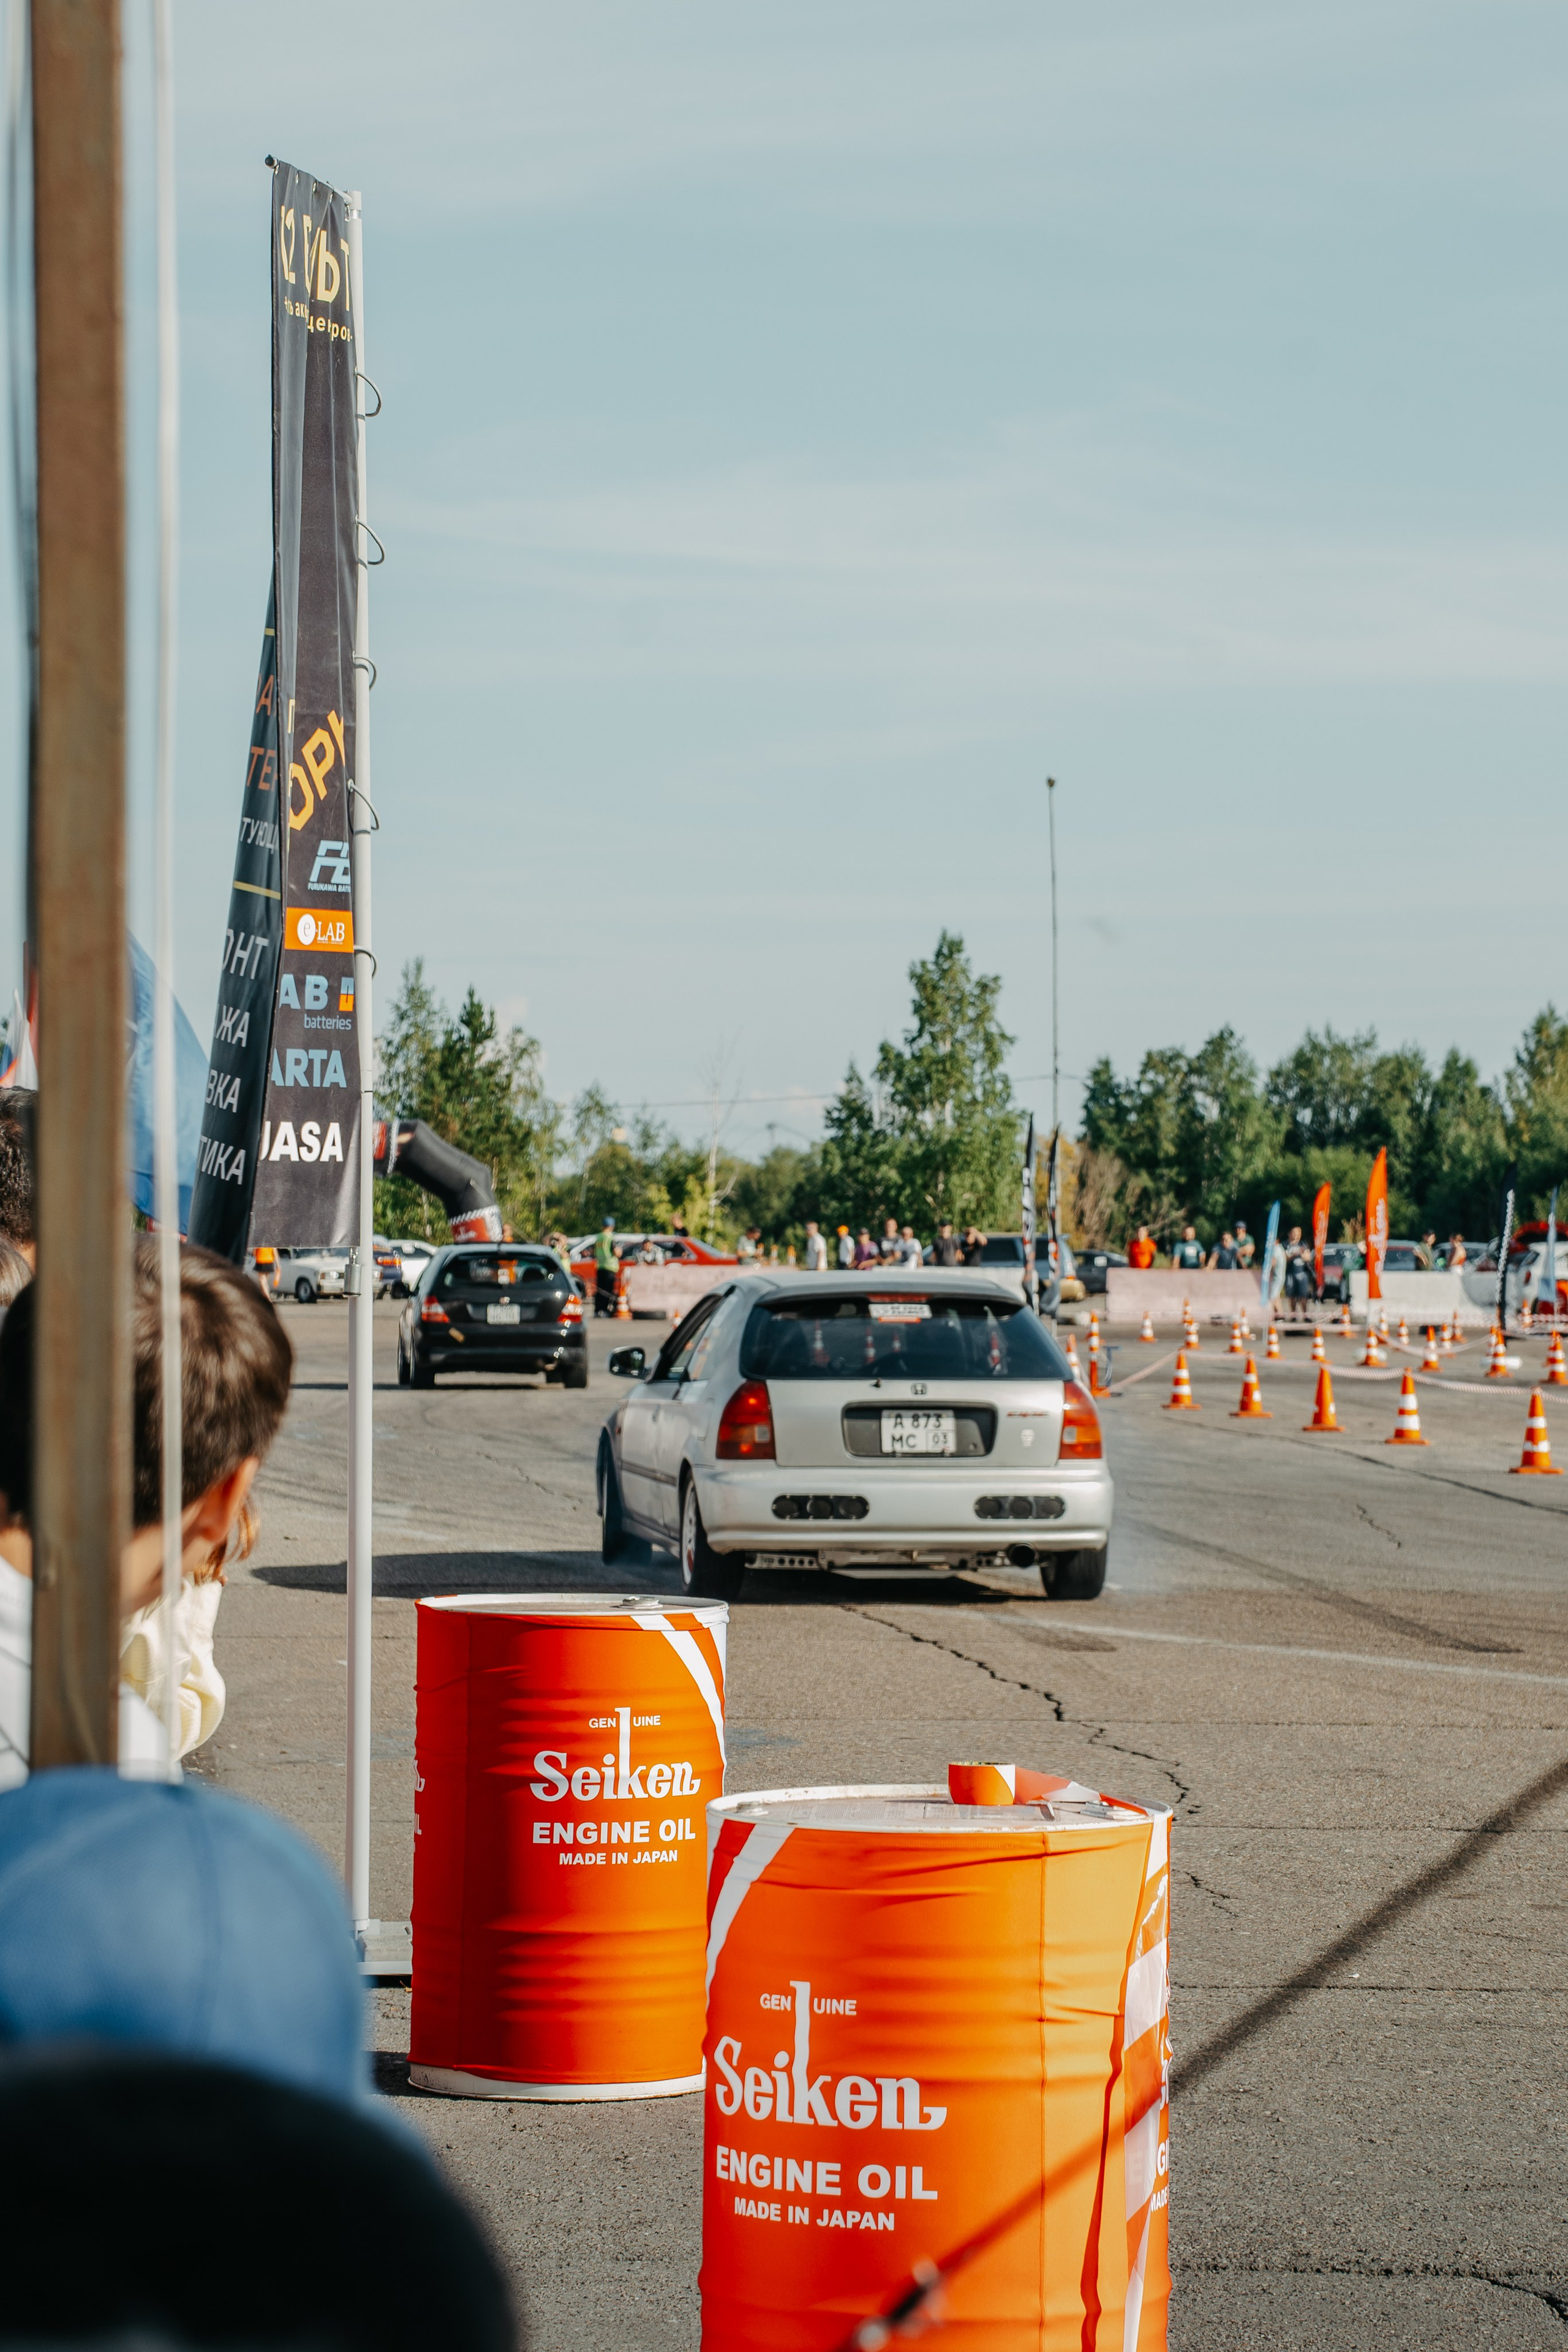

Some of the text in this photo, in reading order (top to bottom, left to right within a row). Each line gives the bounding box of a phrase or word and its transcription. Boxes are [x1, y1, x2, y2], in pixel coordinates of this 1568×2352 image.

[214, 1005, 251, 1048] ЖА
[303, 1014, 352, 1031] batteries
[911, 1413, 942, 1428] 873
[891, 1434, 916, 1448] MC
[589, 1715, 661, 1728] GEN UINE
[530, 1707, 701, 1802] Seiken
[532, 1817, 696, 1845] ENGINE OIL
[559, 1849, 678, 1865] MADE IN JAPAN
[760, 1993, 857, 2016] GEN UINE
[714, 1980, 948, 2130] Seiken
[716, 2144, 938, 2200] ENGINE OIL
[734, 2196, 895, 2231] MADE IN JAPAN
